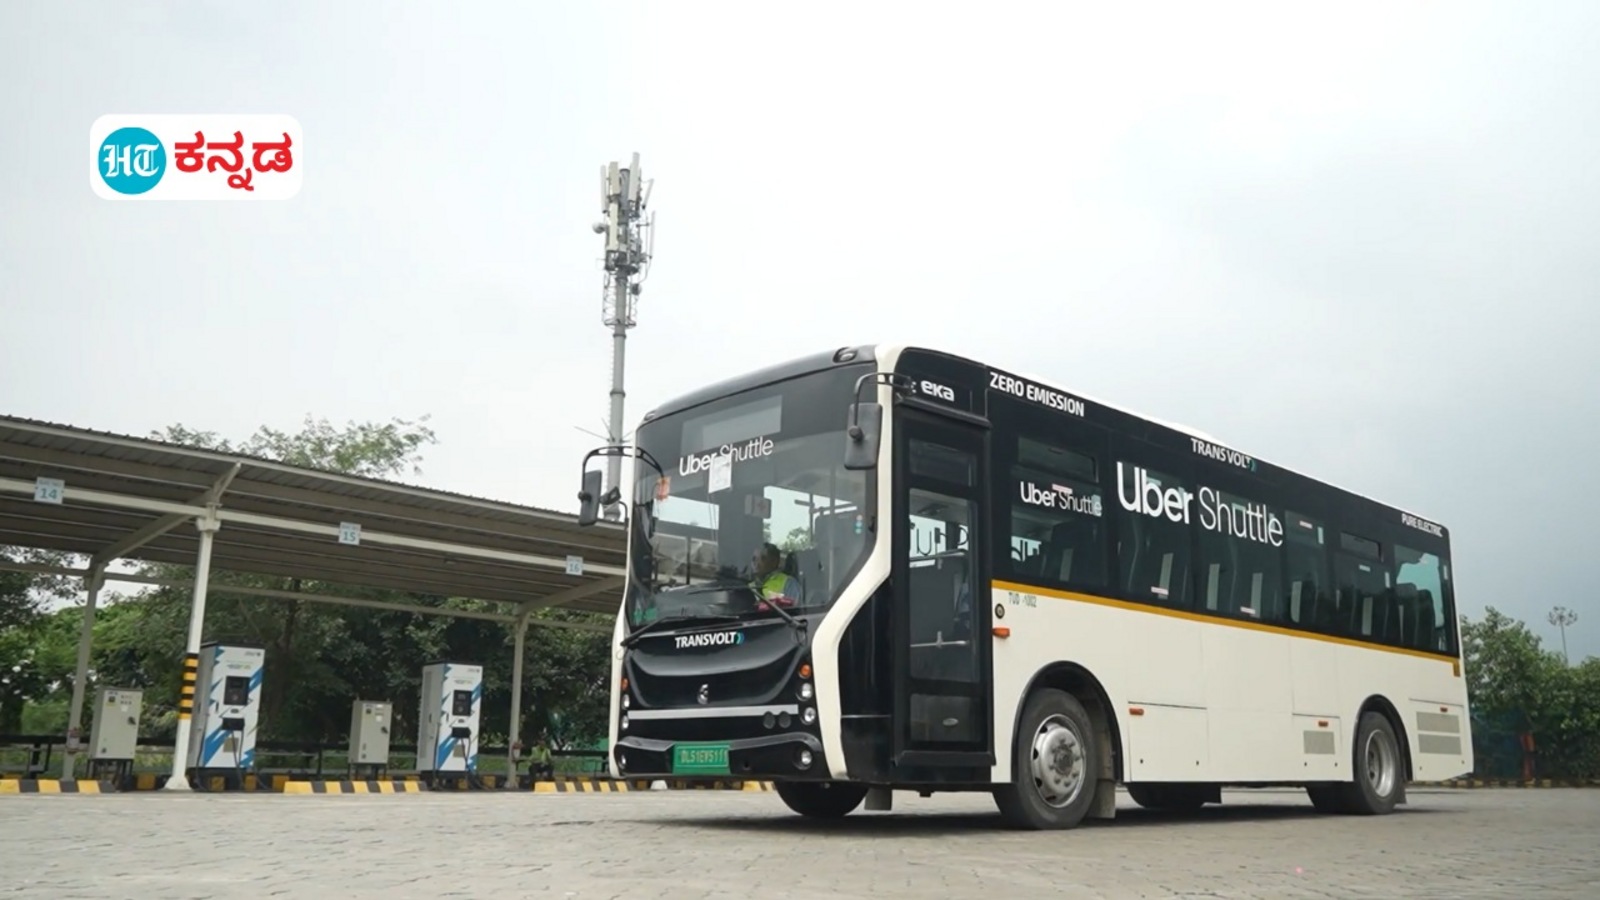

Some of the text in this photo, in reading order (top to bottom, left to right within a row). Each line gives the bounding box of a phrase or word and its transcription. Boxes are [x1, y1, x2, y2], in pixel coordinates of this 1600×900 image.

[990, 371, 1085, 418] ZERO EMISSION
[679, 435, 774, 476] Uber Shuttle
[1190, 437, 1252, 469] TRANSVOLT
[40, 488, 58, 499] 14
[1020, 481, 1102, 517] Uber Shuttle
[1116, 461, 1283, 547] Uber Shuttle
[343, 530, 356, 542] 15
[1401, 512, 1443, 538] PURE ELECTRIC
[569, 562, 580, 573] 16
[674, 630, 737, 649] TRANSVOLT
